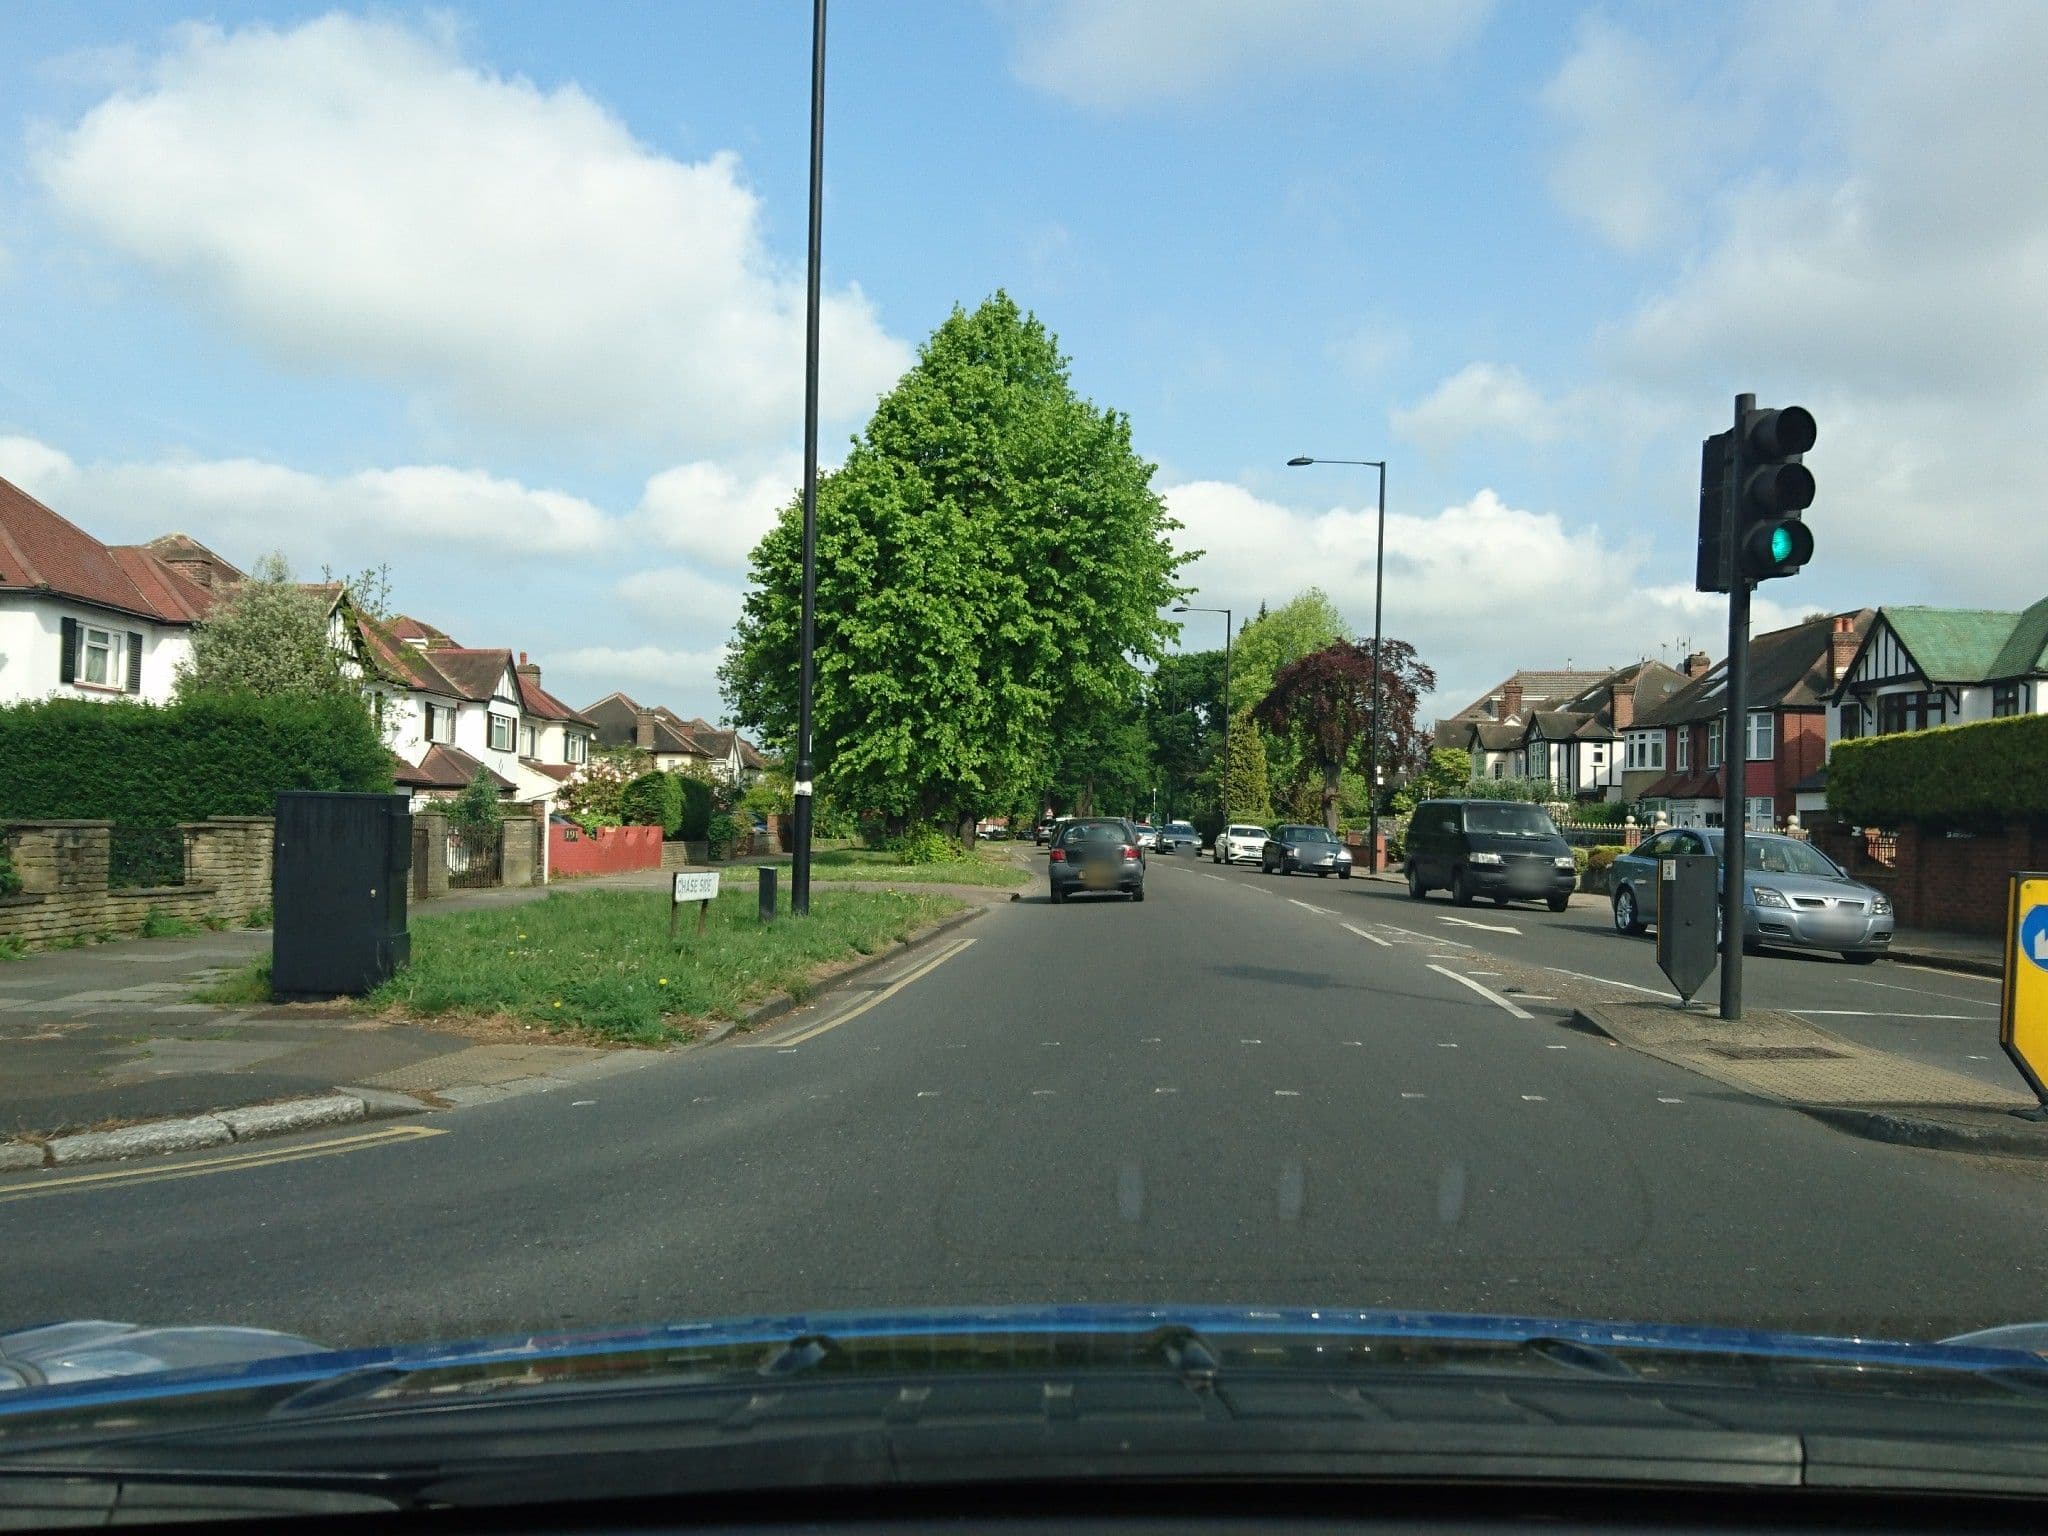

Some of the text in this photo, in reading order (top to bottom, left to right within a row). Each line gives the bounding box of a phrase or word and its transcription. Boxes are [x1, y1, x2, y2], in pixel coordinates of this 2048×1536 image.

[566, 830, 578, 839] 191
[678, 877, 712, 893] CHASE SIDE
